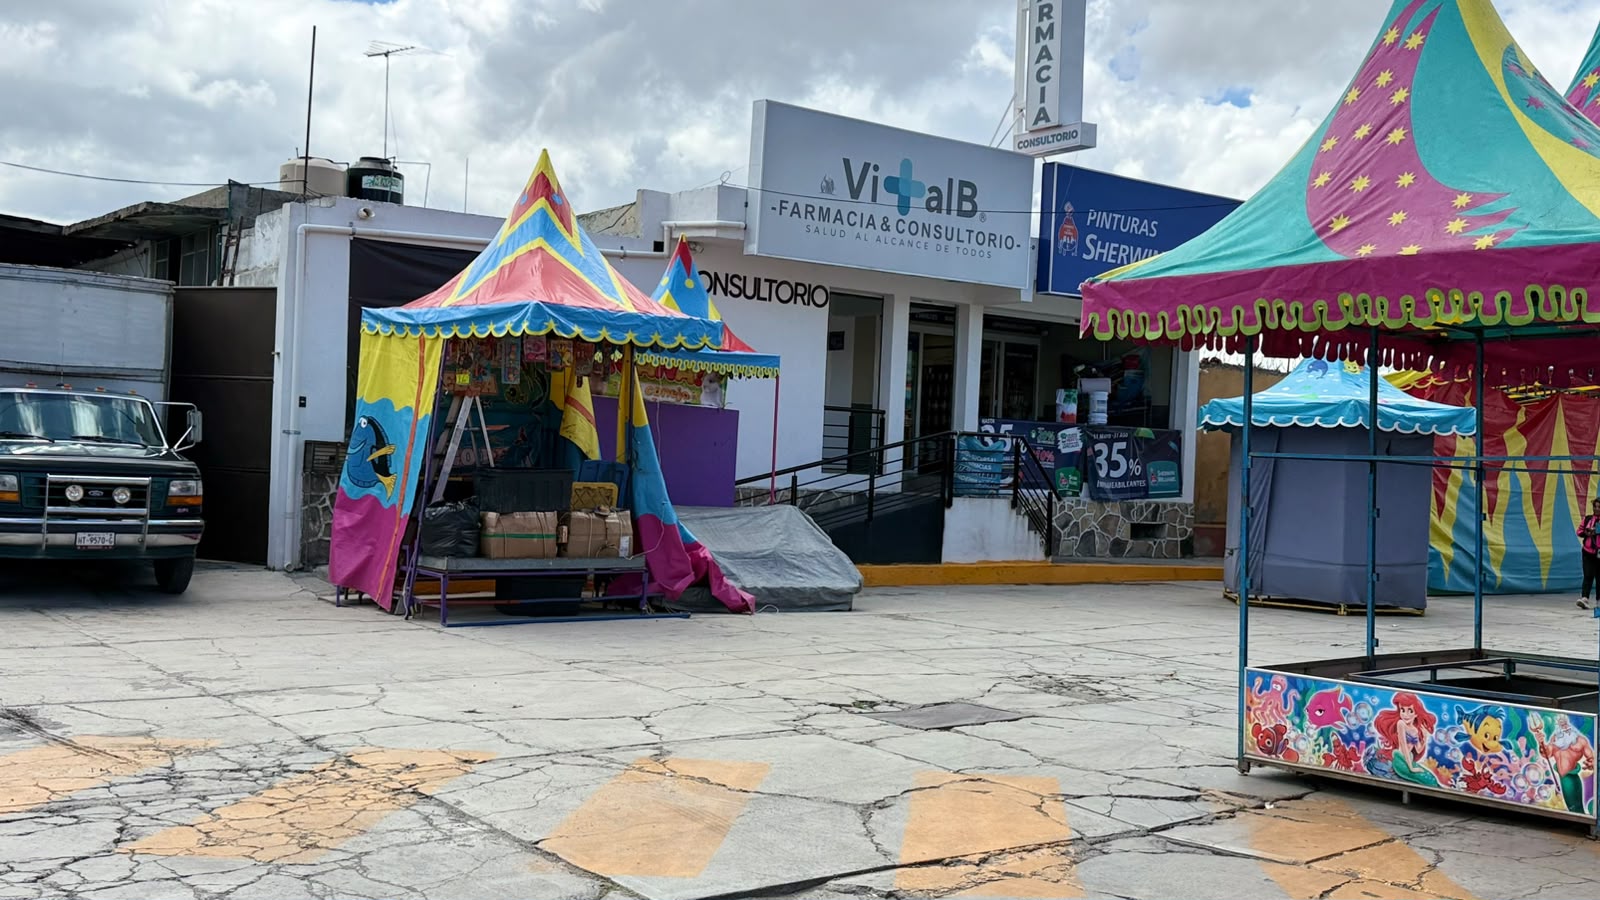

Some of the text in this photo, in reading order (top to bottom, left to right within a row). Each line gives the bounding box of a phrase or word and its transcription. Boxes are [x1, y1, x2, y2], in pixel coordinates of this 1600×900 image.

[1032, 0, 1055, 126] RMACIA
[1017, 129, 1078, 150] CONSULTORIO
[1087, 209, 1158, 238] PINTURAS
[805, 224, 992, 259] SALUD AL ALCANCE DE TODOS
[1082, 233, 1161, 265] SHERW
[698, 270, 829, 308] ONSULTORIO
[1094, 441, 1142, 479] 35%
